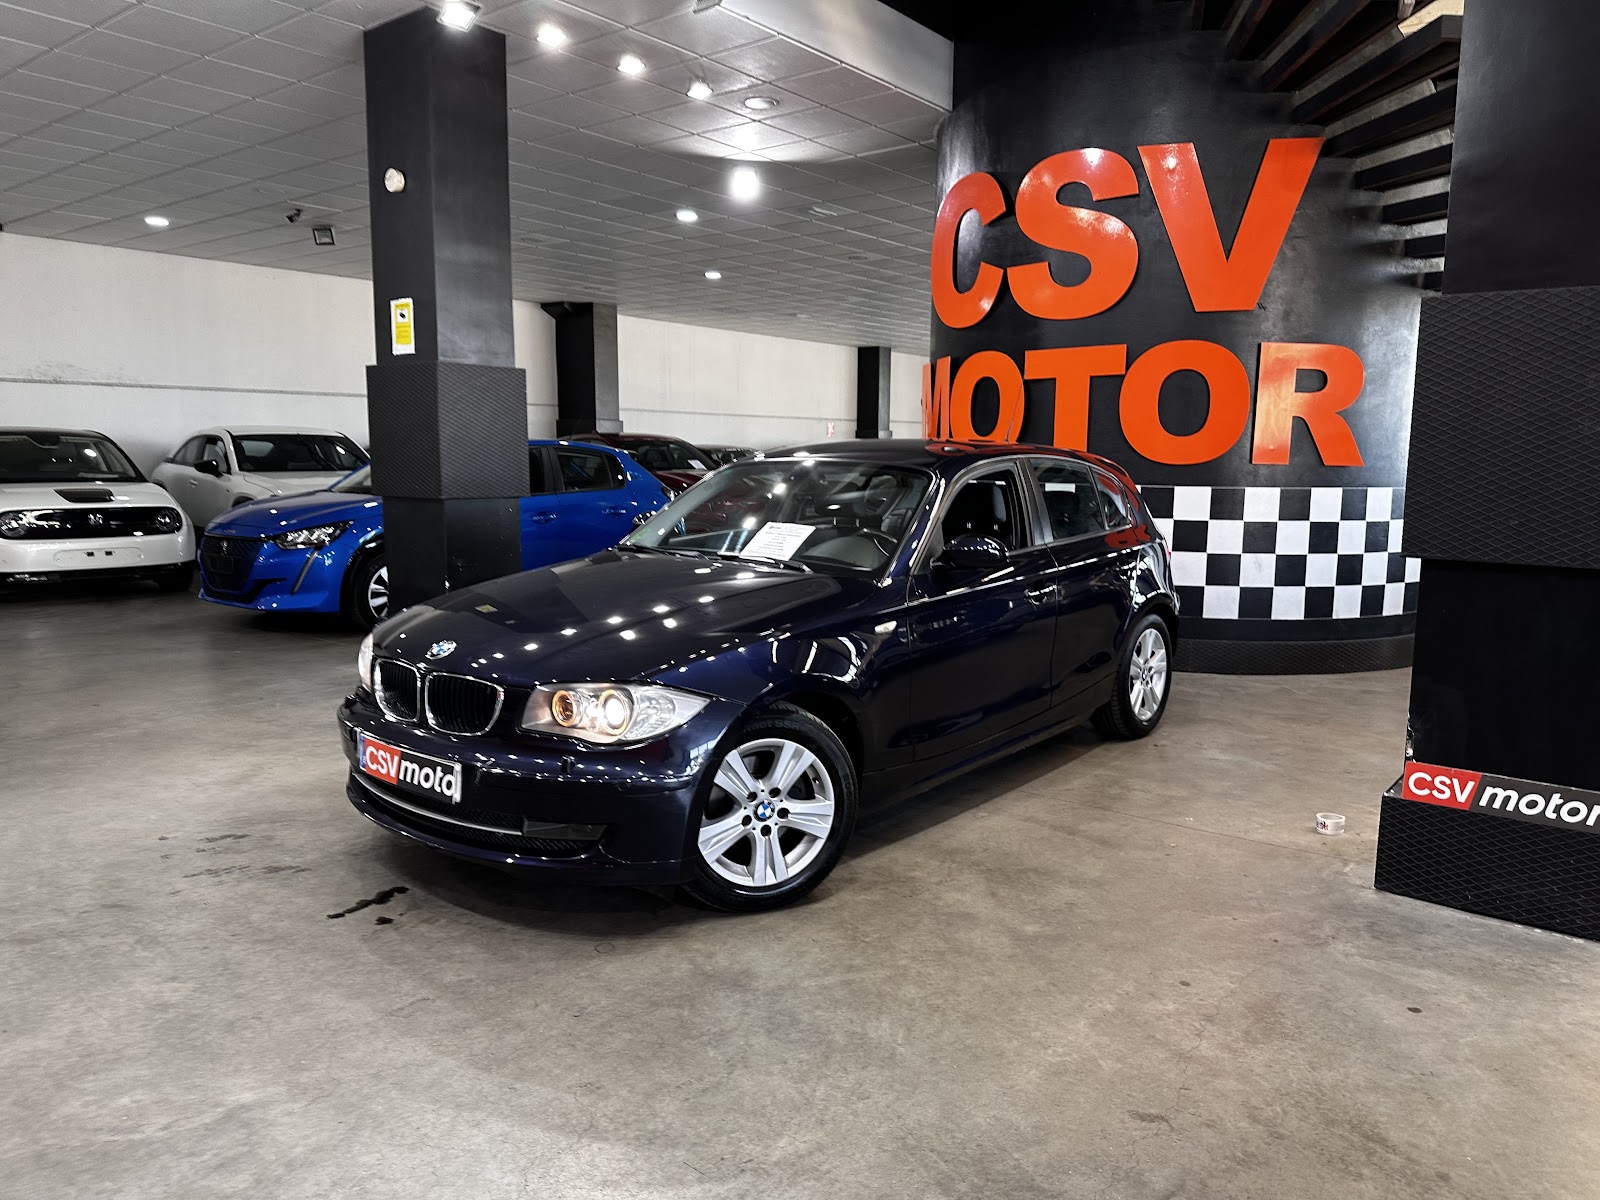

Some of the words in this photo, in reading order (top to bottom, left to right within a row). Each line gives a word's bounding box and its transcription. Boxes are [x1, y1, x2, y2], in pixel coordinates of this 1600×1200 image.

[930, 136, 1326, 329] CSV
[922, 339, 1365, 467] MOTOR
[365, 745, 399, 778] CSV
[1407, 771, 1476, 803] CSV
[1478, 785, 1600, 827] motor
